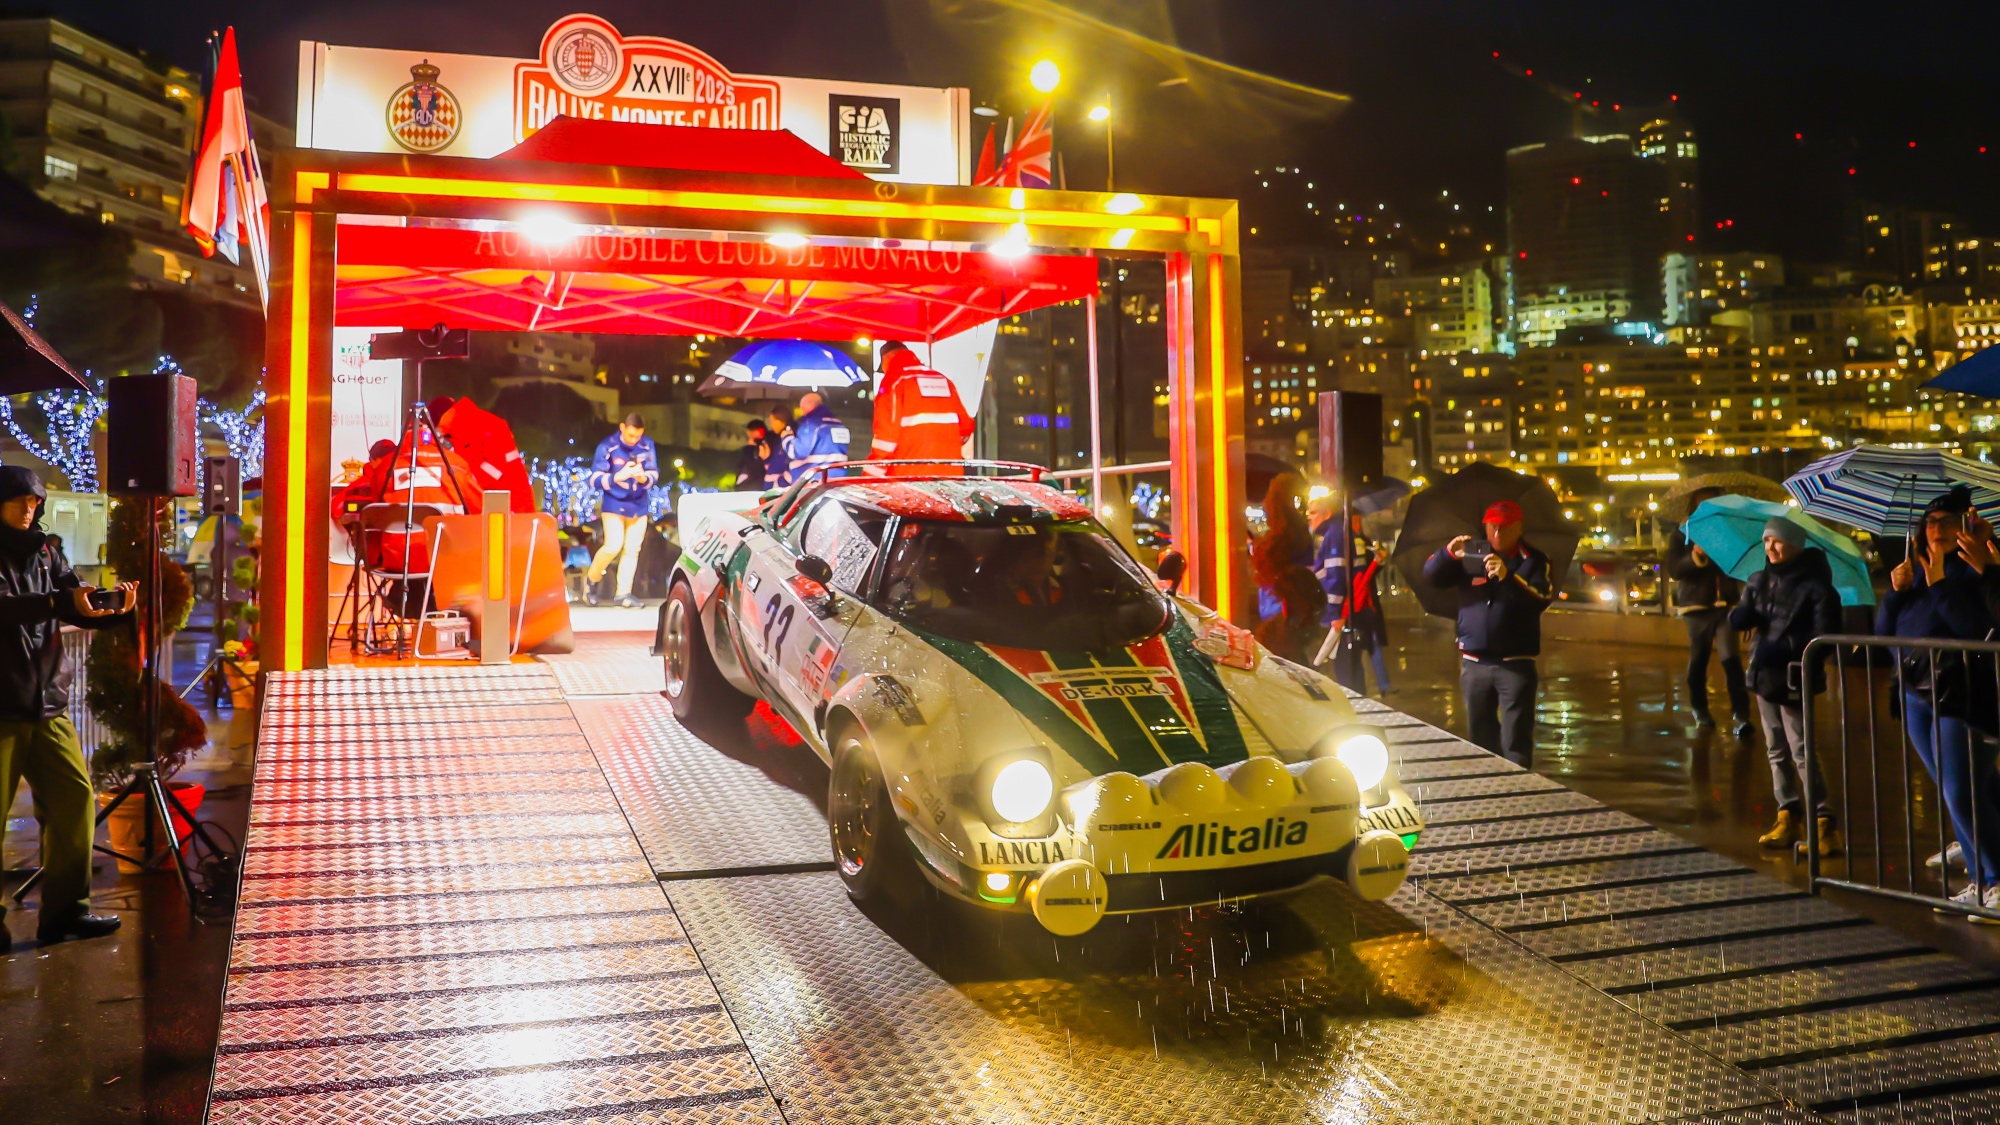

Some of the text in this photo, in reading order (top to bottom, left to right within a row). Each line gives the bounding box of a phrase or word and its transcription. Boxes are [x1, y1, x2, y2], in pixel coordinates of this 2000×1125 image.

[695, 69, 736, 107] 2025
[840, 132, 891, 145] HISTORIC
[843, 147, 886, 164] RALLY
[696, 240, 776, 266] CLUB
[786, 246, 825, 268] DE
[834, 246, 962, 274] MONACO
[1155, 816, 1309, 860] Alitalia
[979, 841, 1065, 865] LANCIA
